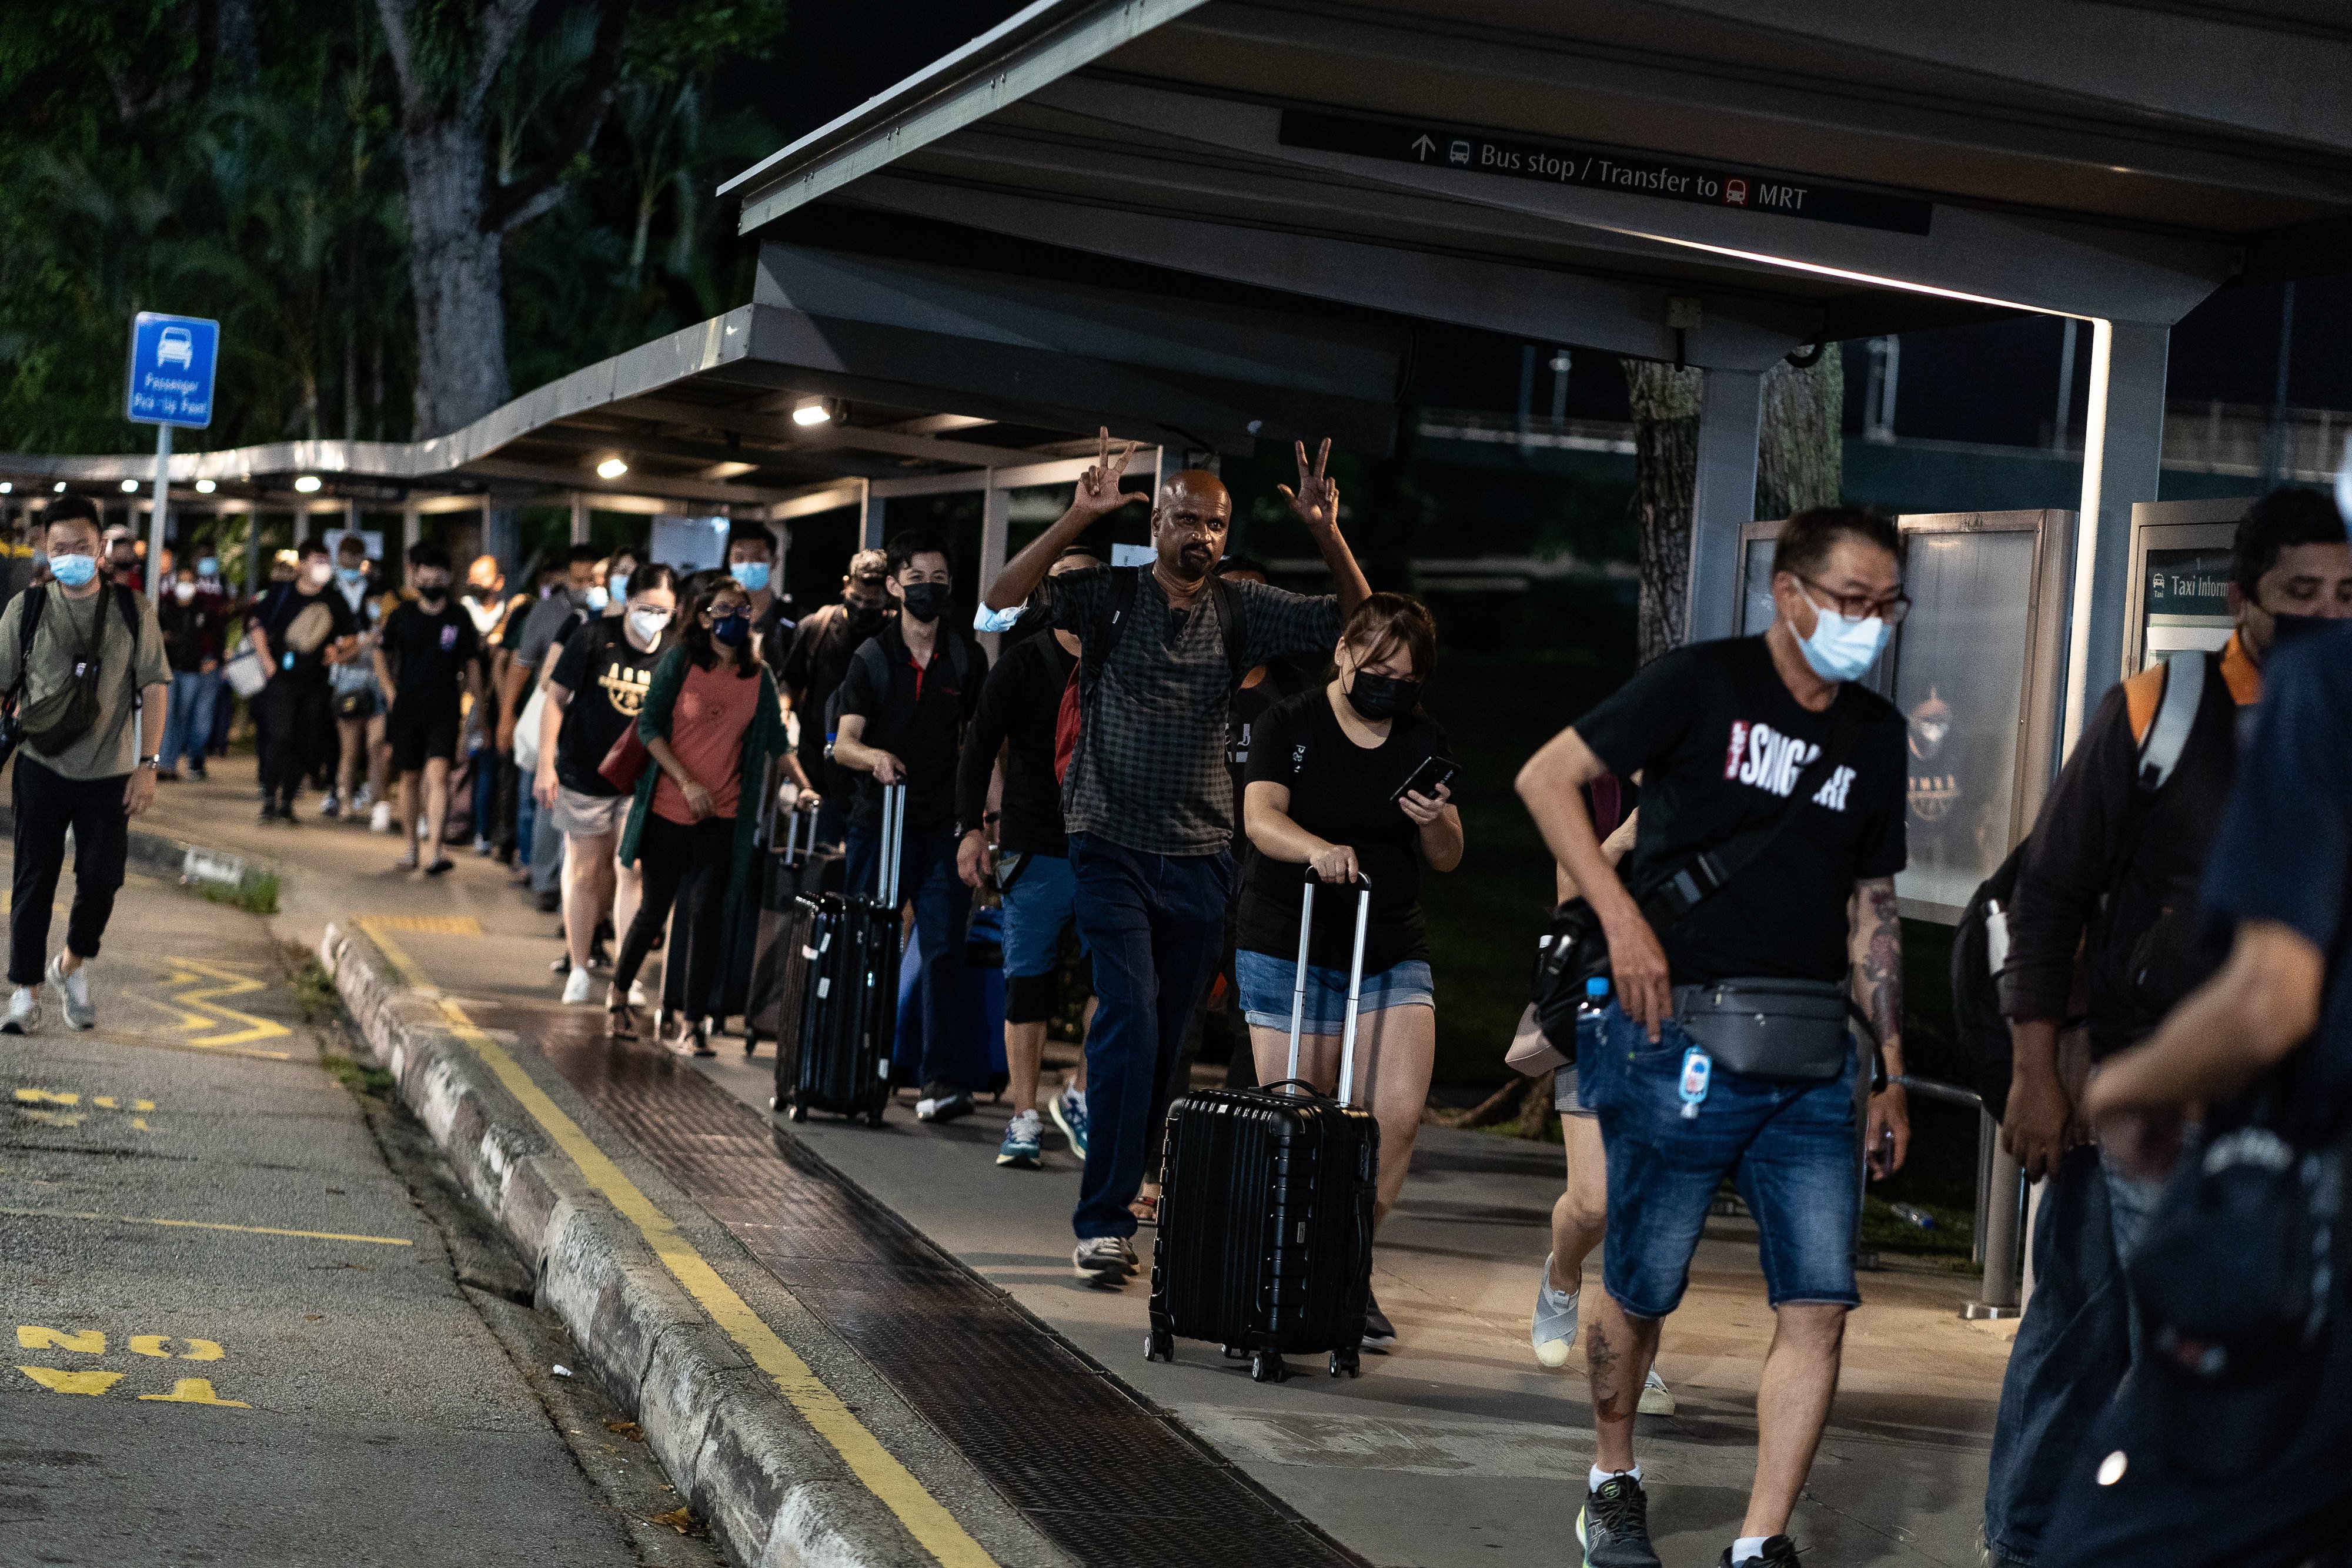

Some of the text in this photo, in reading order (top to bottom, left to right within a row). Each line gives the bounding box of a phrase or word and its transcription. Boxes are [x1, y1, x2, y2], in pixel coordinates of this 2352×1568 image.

[1481, 144, 1521, 169] Bus
[1528, 153, 1575, 181] stop
[1599, 160, 1690, 193] Transfer
[1696, 175, 1718, 197] to
[1758, 183, 1808, 209] MRT
[2171, 576, 2229, 597] Taxi Inform
